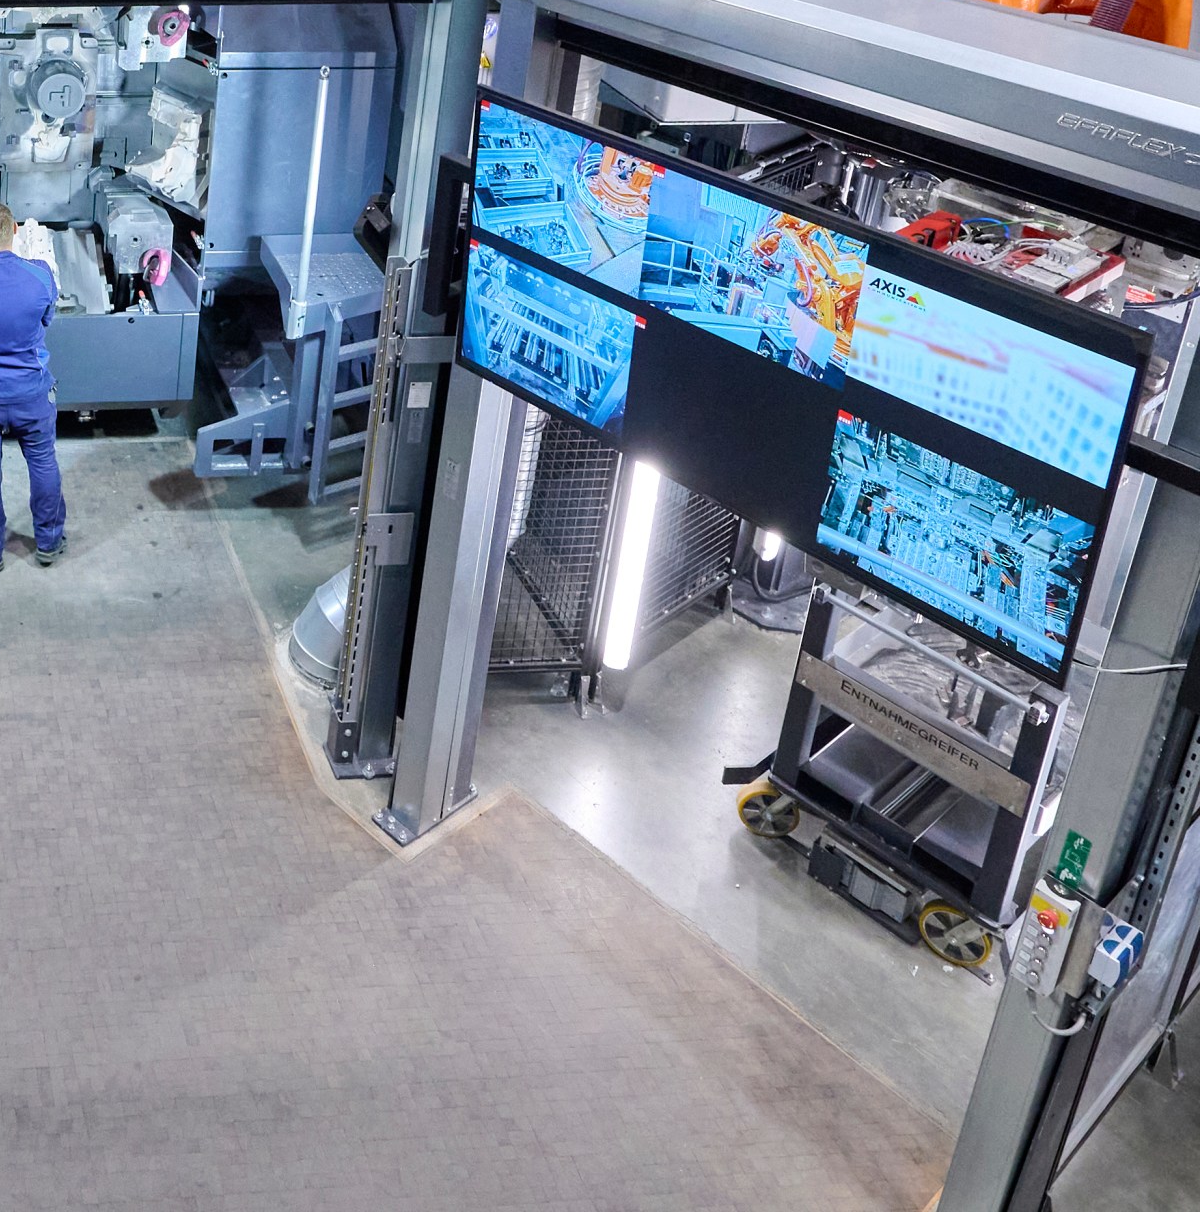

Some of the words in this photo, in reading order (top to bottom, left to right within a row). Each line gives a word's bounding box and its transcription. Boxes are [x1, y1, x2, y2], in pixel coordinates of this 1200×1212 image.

[1056, 112, 1187, 161] EFAFLEX
[868, 277, 907, 299] AXIS
[840, 678, 980, 771] ENTNAHMEGREIFER
